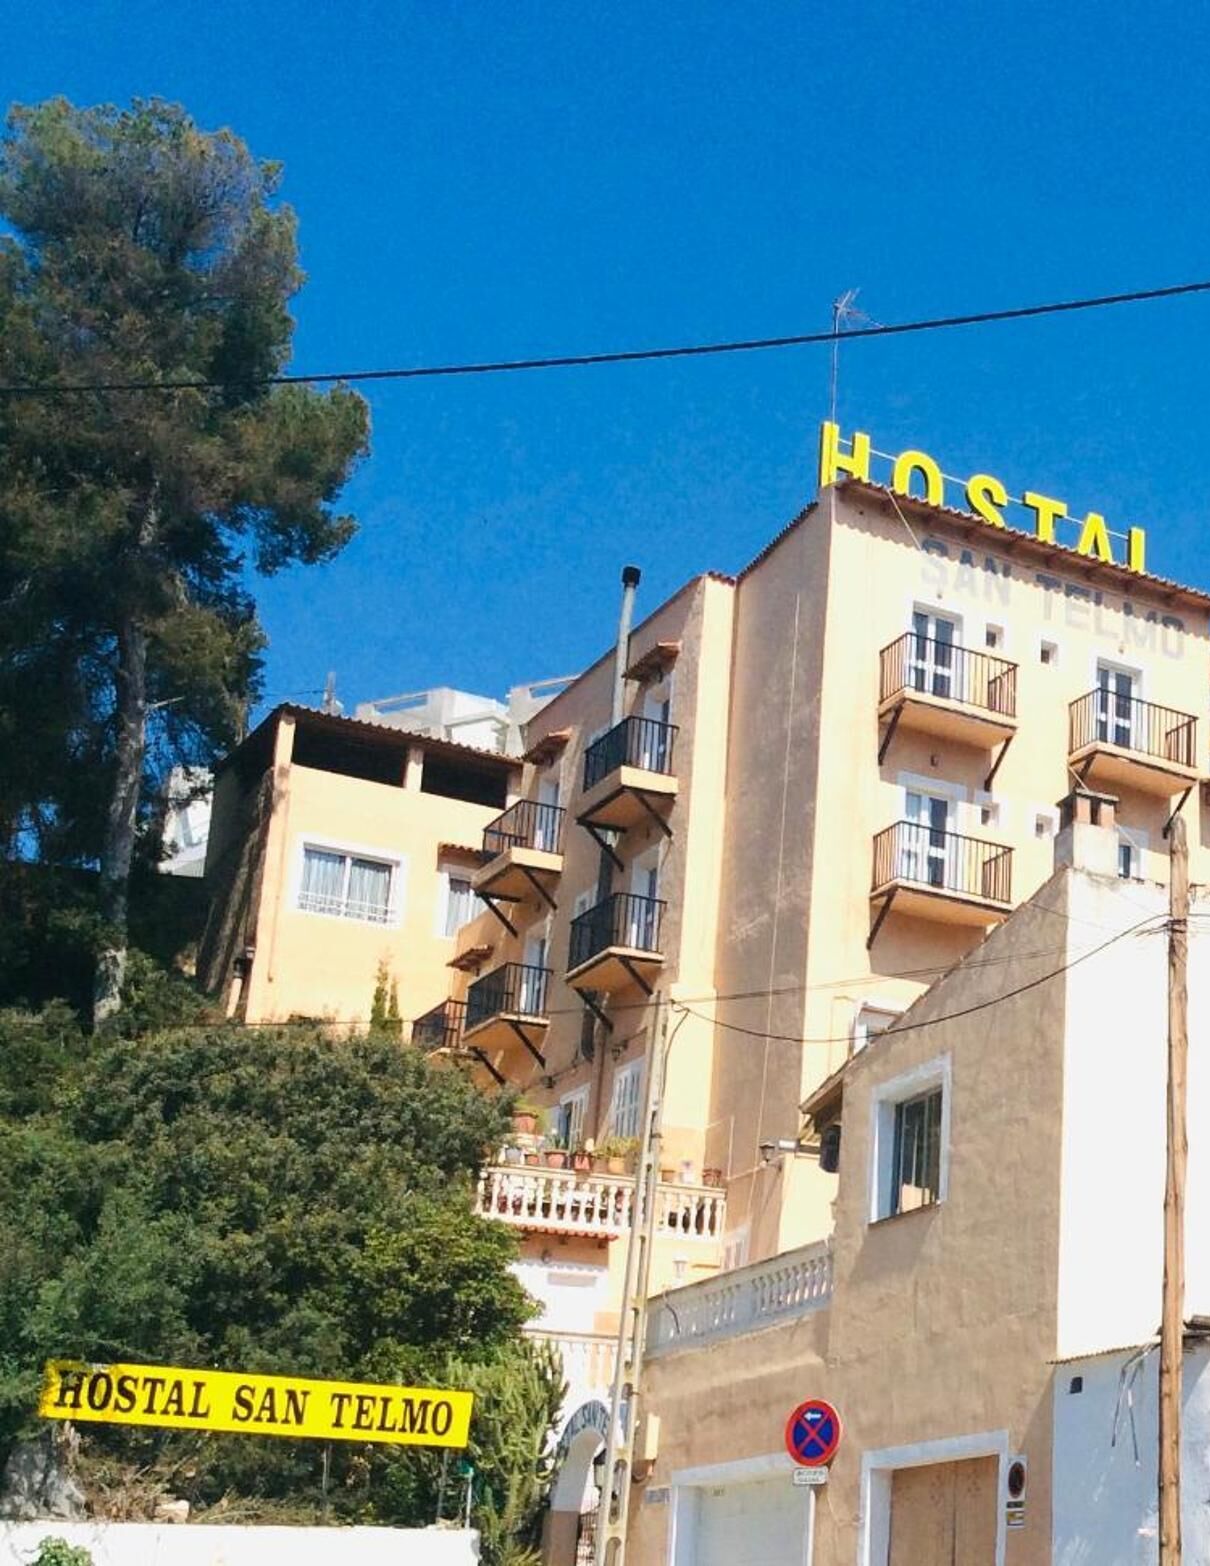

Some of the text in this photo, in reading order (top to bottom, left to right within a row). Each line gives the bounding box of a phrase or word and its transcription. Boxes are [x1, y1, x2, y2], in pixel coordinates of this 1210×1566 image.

[920, 537, 1185, 659] SAN TELMO
[54, 1369, 453, 1436] HOSTAL SAN TELMO
